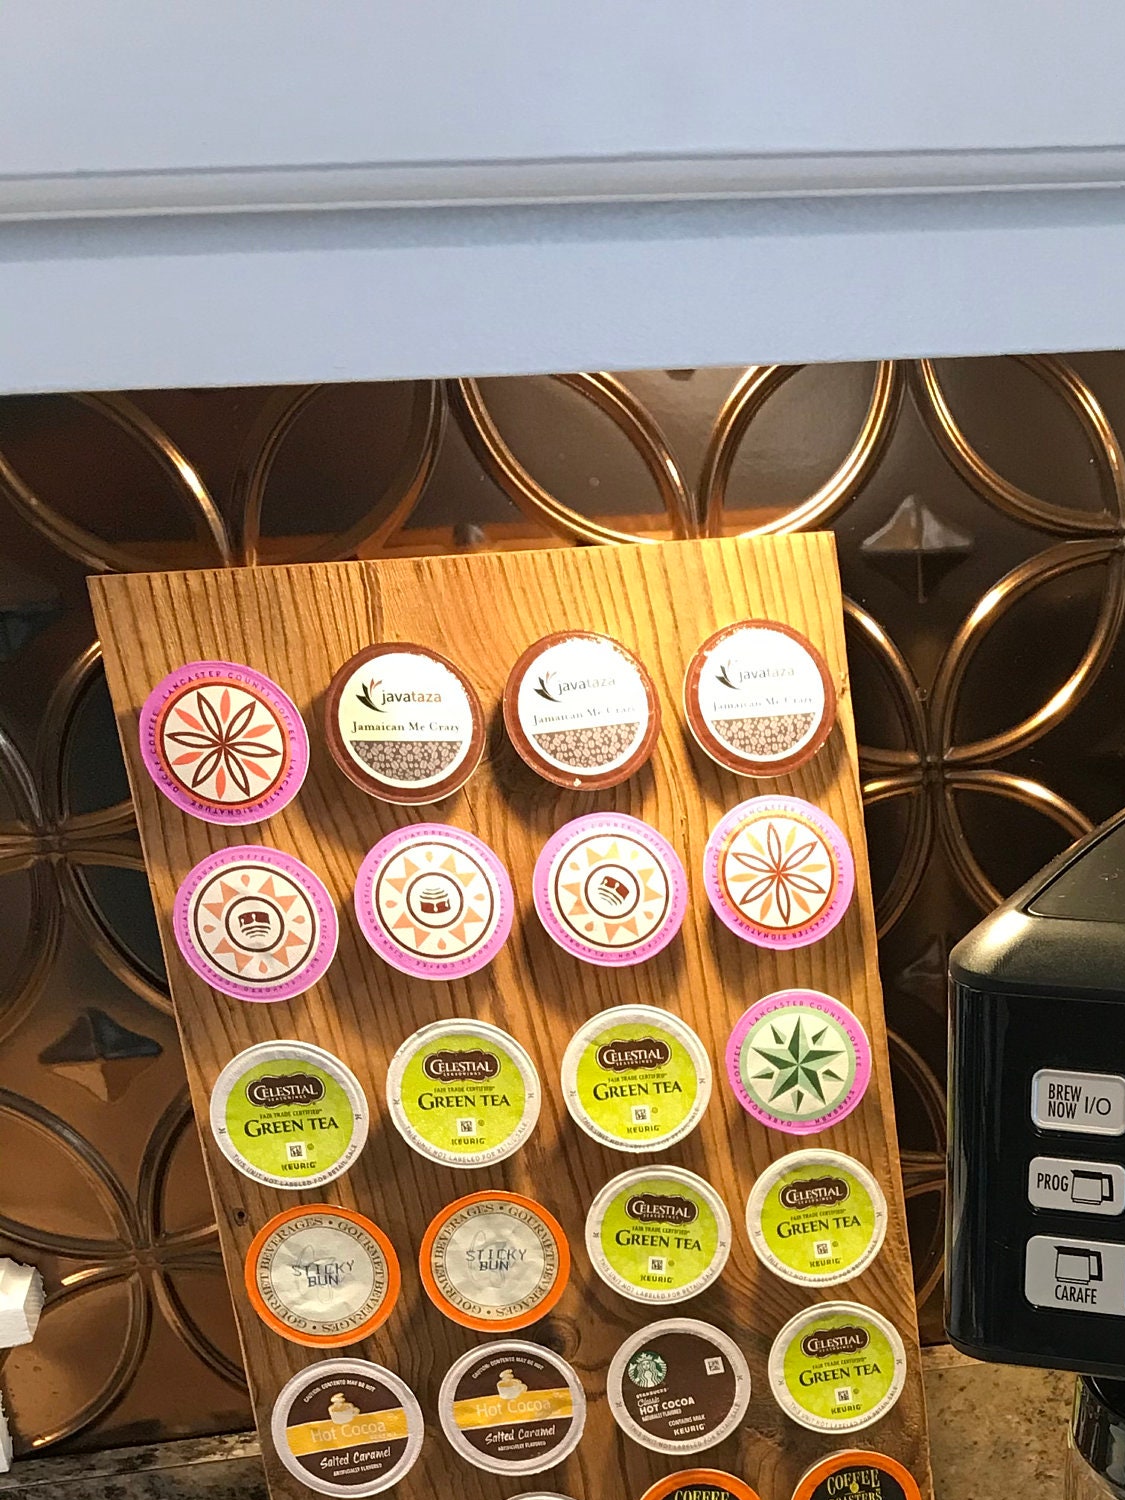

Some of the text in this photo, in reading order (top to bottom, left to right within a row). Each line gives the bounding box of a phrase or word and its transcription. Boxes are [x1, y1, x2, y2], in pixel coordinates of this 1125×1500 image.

[739, 668, 795, 682] javataza
[162, 671, 221, 700] LANCASTER
[228, 672, 270, 697] COUNTY
[558, 678, 615, 695] javataza
[381, 690, 442, 705] javataza
[351, 721, 404, 733] Jamaican
[409, 722, 425, 731] Me
[749, 1001, 861, 1067] LANCASTER COUNTY COFFEE
[603, 1048, 664, 1065] CELESTIAL
[430, 1059, 493, 1074] CELESTIAL
[253, 1084, 318, 1100] CELESTIAL
[593, 1081, 682, 1100] GREEN TEA
[1048, 1083, 1081, 1103] BREW
[418, 1093, 511, 1110] GREEN TEA
[1048, 1100, 1077, 1119] NOW
[245, 1117, 338, 1138] GREEN TEA
[627, 1125, 661, 1134] KEURIG
[282, 1162, 316, 1171] KEURIG
[1036, 1172, 1069, 1192] PROG
[786, 1186, 844, 1204] CELESTIAL
[632, 1200, 691, 1218] CELESTIAL
[435, 1204, 495, 1258] BEVERAGES
[508, 1207, 555, 1262] GOURMET
[777, 1215, 861, 1238] GREEN TEA
[261, 1218, 324, 1269] BEVERAGES
[338, 1221, 384, 1279] GOURMET
[616, 1230, 670, 1248] GREEN
[675, 1238, 702, 1251] TEA
[466, 1249, 527, 1262] STICKY
[810, 1258, 841, 1268] KEURIG
[291, 1260, 355, 1276] STICKY
[479, 1261, 509, 1271] BUN
[308, 1275, 339, 1287] BUN
[641, 1274, 674, 1283] KEURIG
[435, 1262, 482, 1315] GOURMET
[495, 1264, 554, 1317] BEVERAGES
[1055, 1285, 1097, 1305] CARAFE
[260, 1274, 307, 1329] GOURMET
[321, 1281, 384, 1332] BEVERAGES
[808, 1335, 864, 1352] CELESTIAL
[799, 1368, 850, 1386] GREEN
[854, 1363, 882, 1376] TEA
[639, 1404, 659, 1416] HOT
[662, 1397, 695, 1410] COCOA
[831, 1404, 862, 1415] KEURIG
[485, 1424, 556, 1445] Salted Caramel
[673, 1424, 705, 1436] KEURIG
[320, 1453, 350, 1470] Salted
[353, 1446, 391, 1464] Caramel
[827, 1469, 880, 1495] COFFEE
